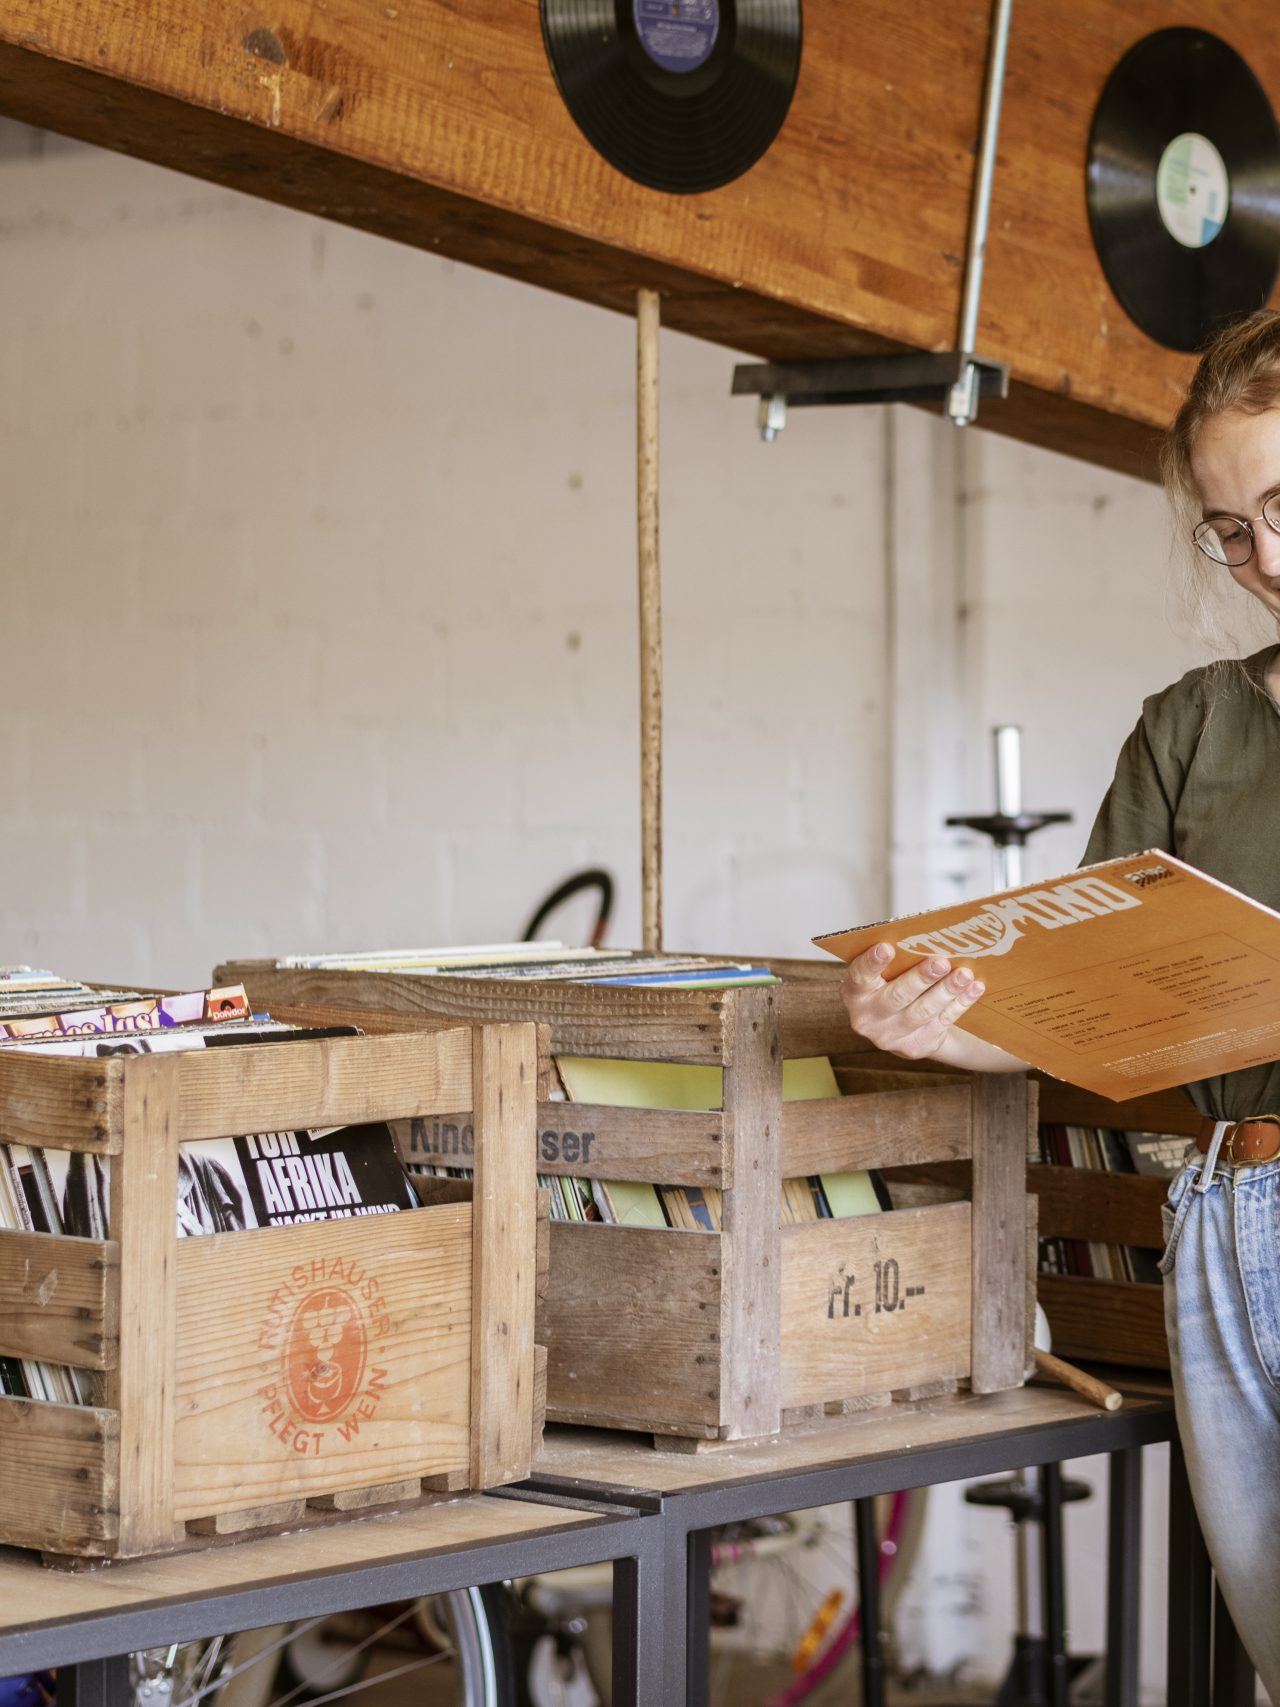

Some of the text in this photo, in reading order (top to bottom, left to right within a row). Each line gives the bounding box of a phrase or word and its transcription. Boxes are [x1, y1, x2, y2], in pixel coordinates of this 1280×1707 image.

[981, 877, 1143, 931] MINO
[256, 1151, 363, 1214] AFRIKA
[257, 1256, 393, 1351] RUTISHAUSER
[256, 1366, 388, 1456] PFLEGT WEIN
